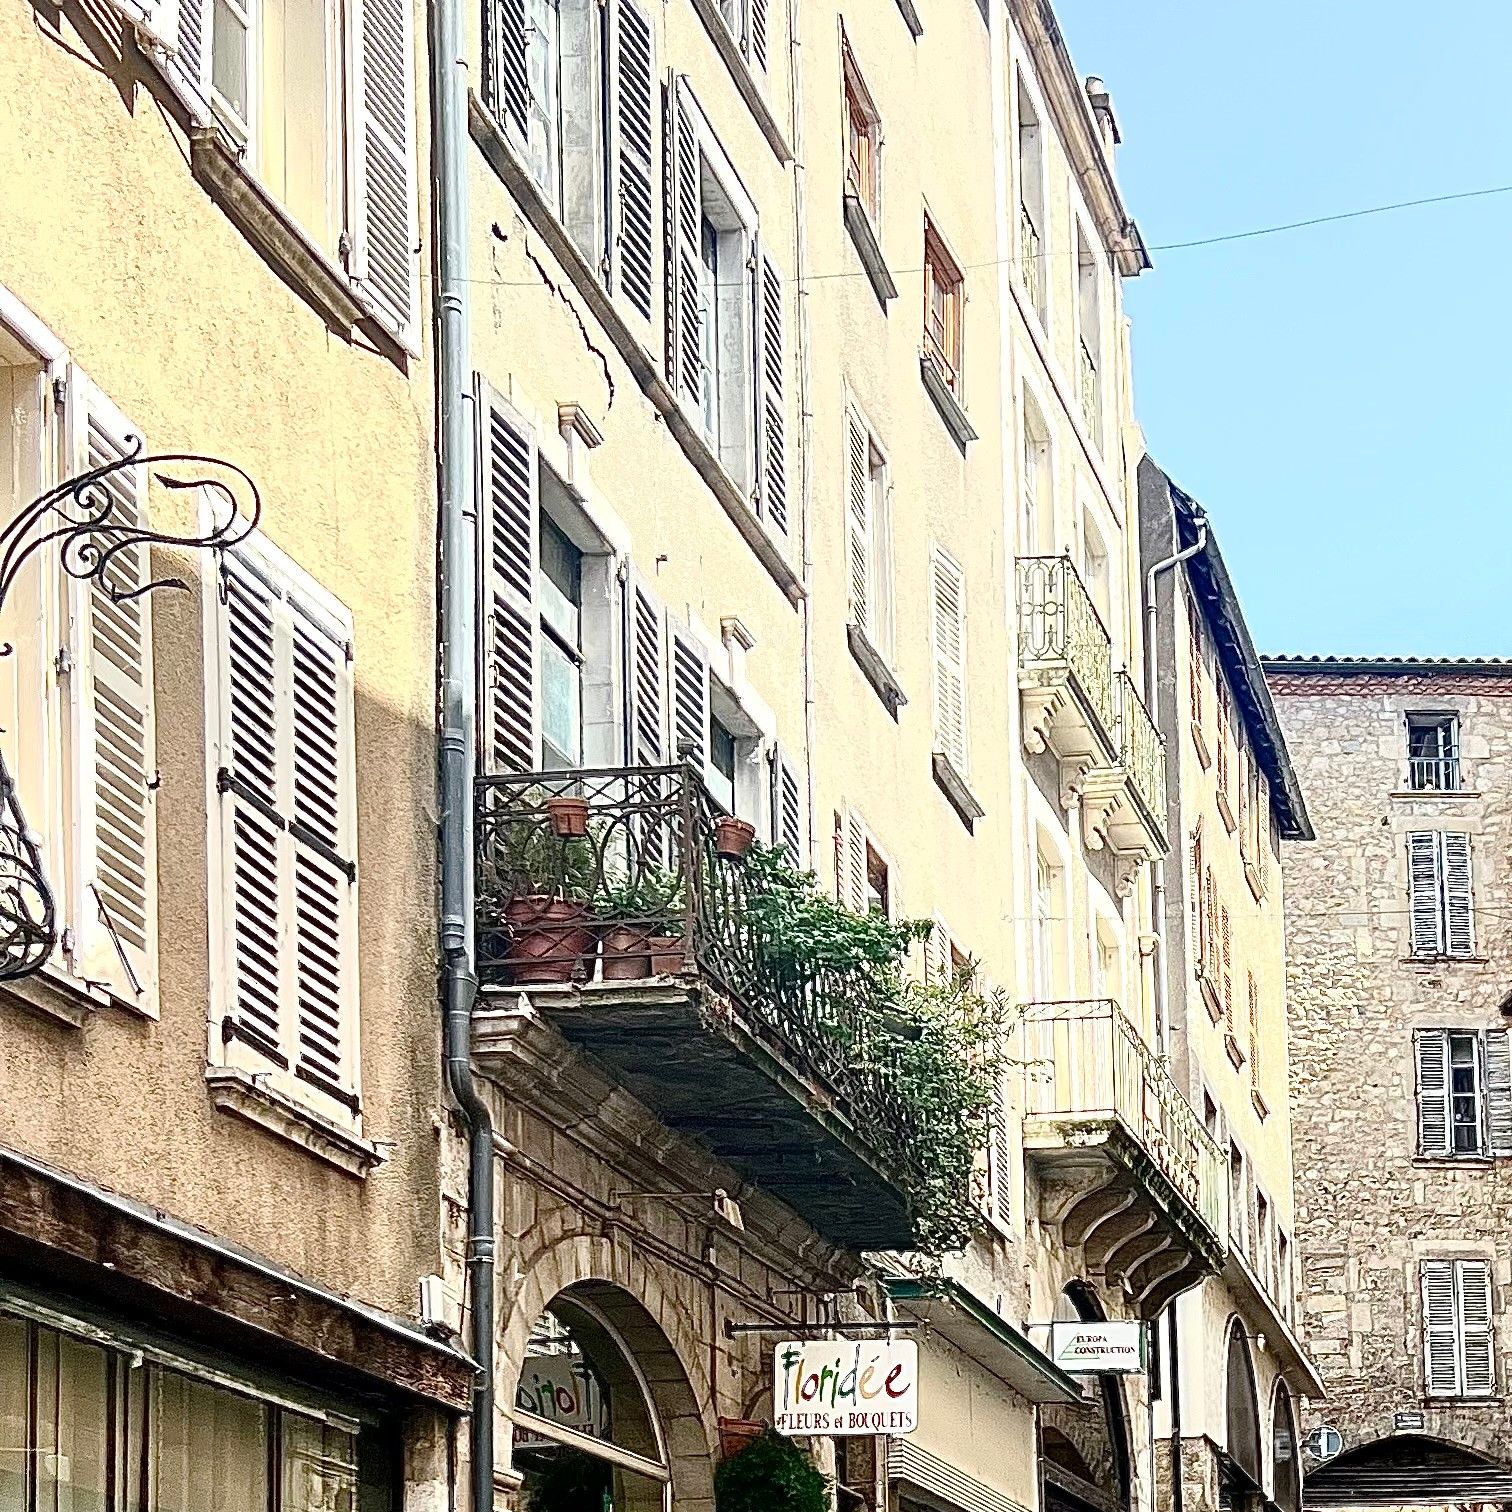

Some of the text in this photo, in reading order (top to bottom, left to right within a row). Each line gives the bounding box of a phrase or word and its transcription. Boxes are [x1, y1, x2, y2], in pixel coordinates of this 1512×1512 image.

[1076, 1335, 1108, 1343] EUROPA
[1074, 1346, 1136, 1354] CONSTRUCTION
[781, 1343, 911, 1411] Floridée
[781, 1412, 912, 1431] FLEURS et BOUQUETS
